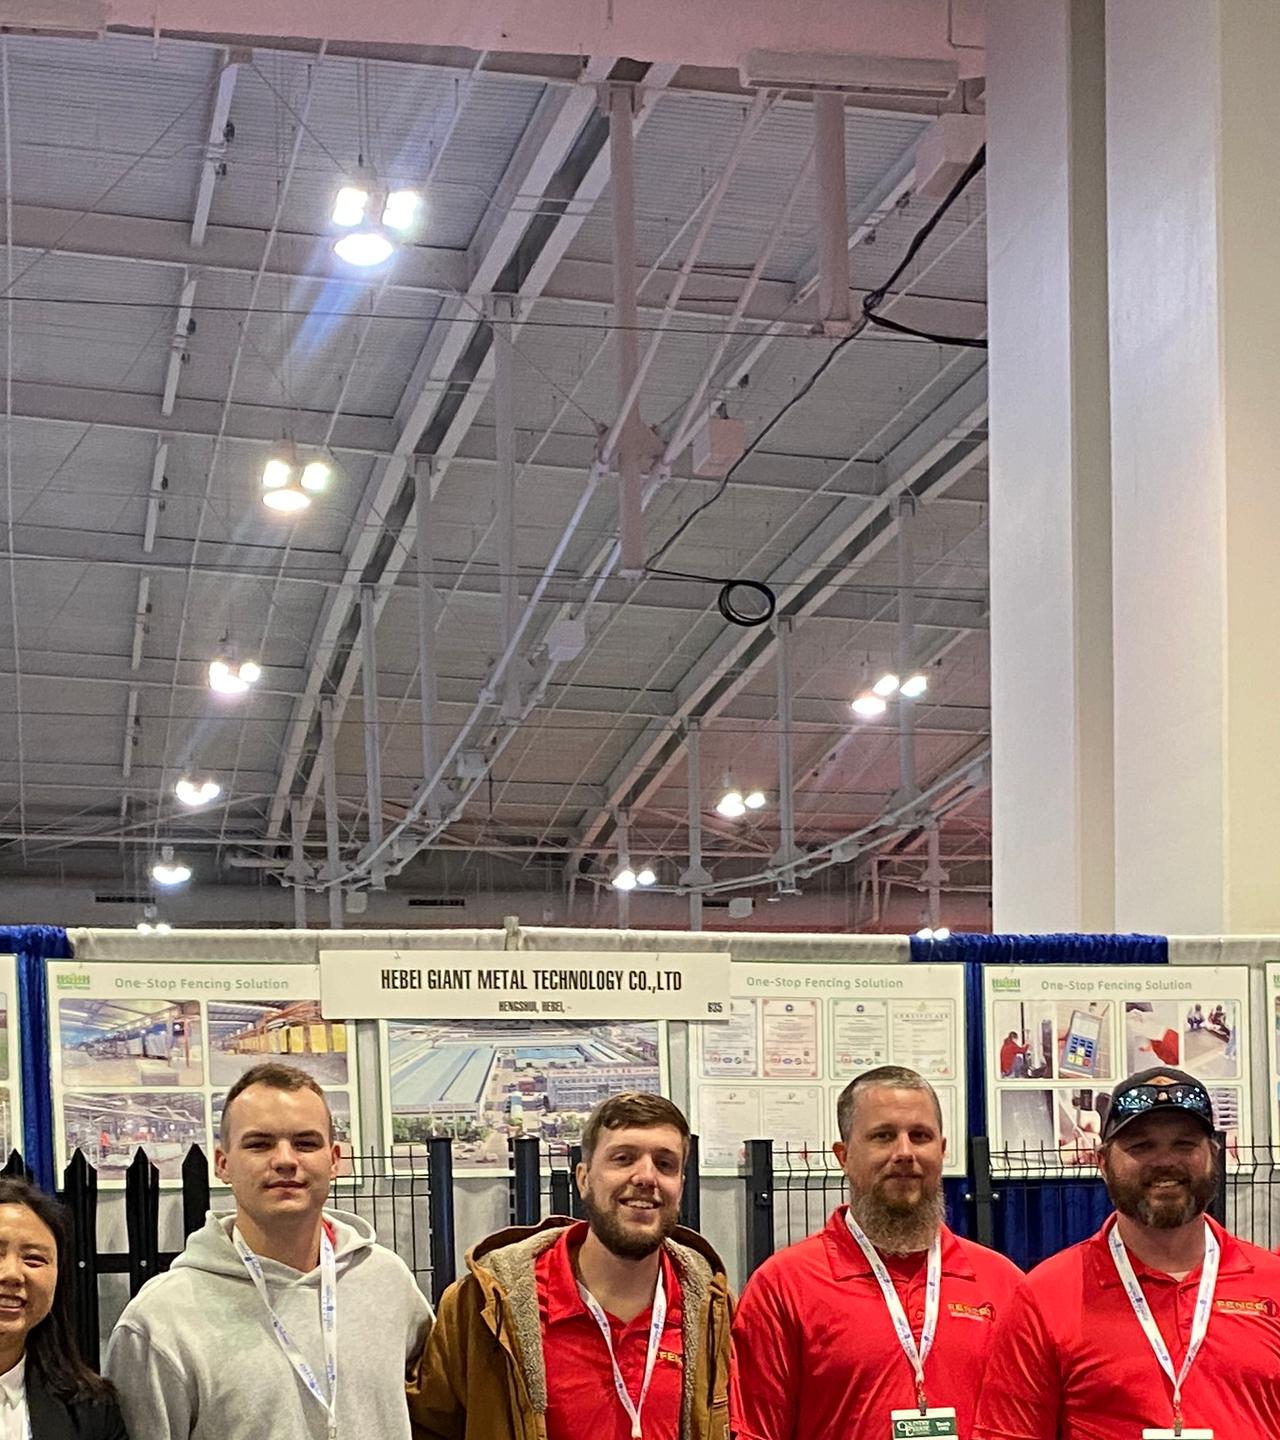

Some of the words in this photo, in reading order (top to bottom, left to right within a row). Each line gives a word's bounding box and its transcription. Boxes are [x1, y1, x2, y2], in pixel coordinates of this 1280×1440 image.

[115, 978, 176, 991] One-Stop
[181, 978, 231, 991] Fencing
[235, 978, 289, 990] Solution
[381, 969, 420, 989] HEBEI
[427, 969, 472, 989] GIANT
[478, 970, 527, 990] METAL
[533, 970, 624, 990] TECHNOLOGY
[629, 971, 682, 994] CO.,LTD
[746, 976, 801, 989] One-Stop
[806, 977, 850, 990] Fencing
[855, 977, 903, 989] Solution
[1041, 980, 1094, 992] One-Stop
[1098, 980, 1141, 992] Fencing
[1146, 980, 1192, 991] Solution
